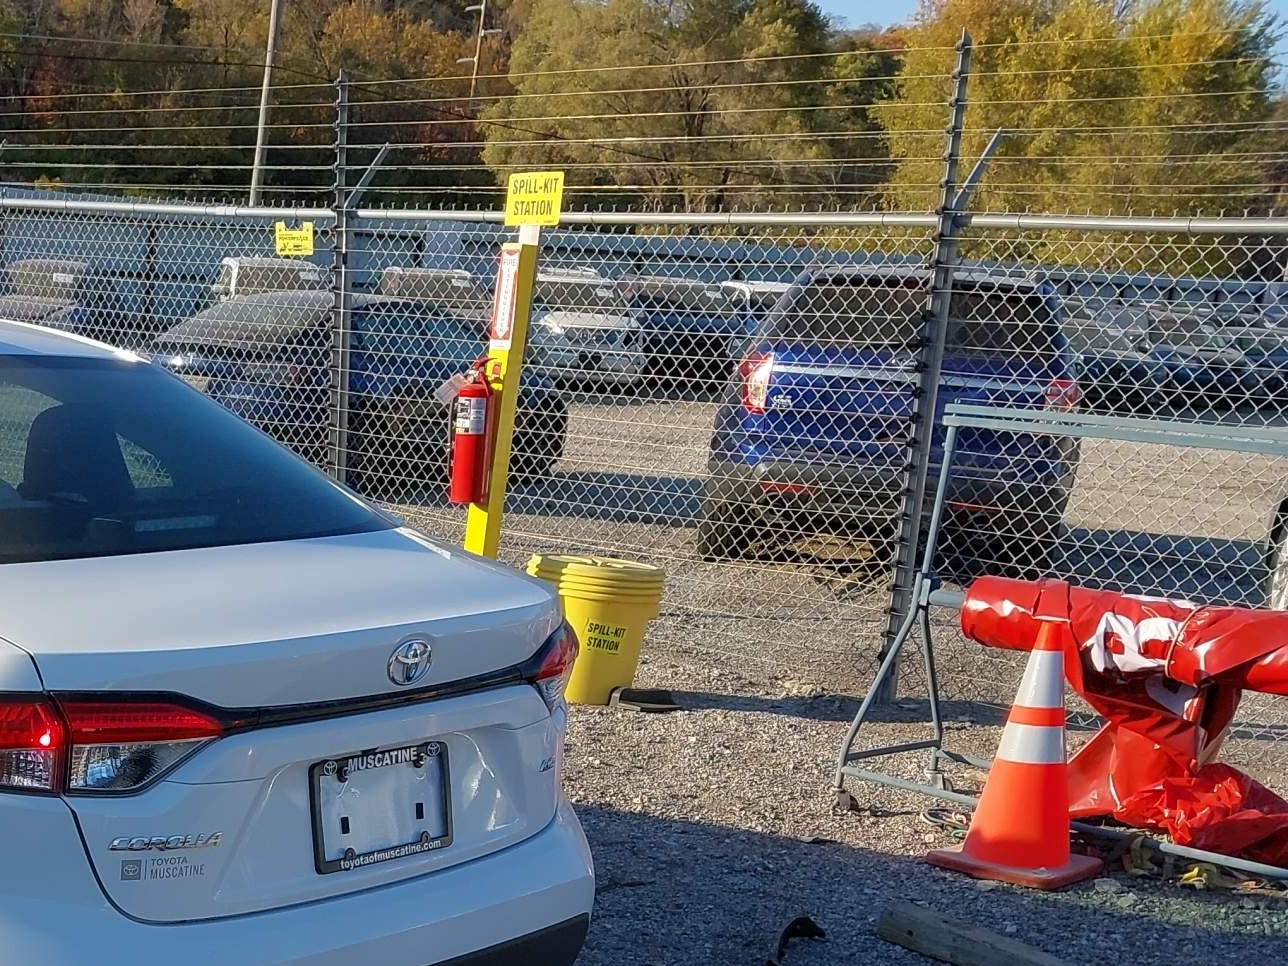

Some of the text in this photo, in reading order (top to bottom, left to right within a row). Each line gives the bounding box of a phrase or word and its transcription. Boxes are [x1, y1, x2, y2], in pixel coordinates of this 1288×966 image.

[513, 178, 559, 194] SPILL-KIT
[514, 200, 553, 215] STATION
[588, 622, 626, 638] SPILL-KIT
[587, 636, 620, 651] STATION
[347, 747, 417, 771] MUSCATINE
[108, 831, 223, 852] COROLLA
[152, 856, 188, 866] TOYOTA
[340, 840, 441, 869] toyotaofmuscatine.com
[151, 864, 205, 880] MUSCATINE
